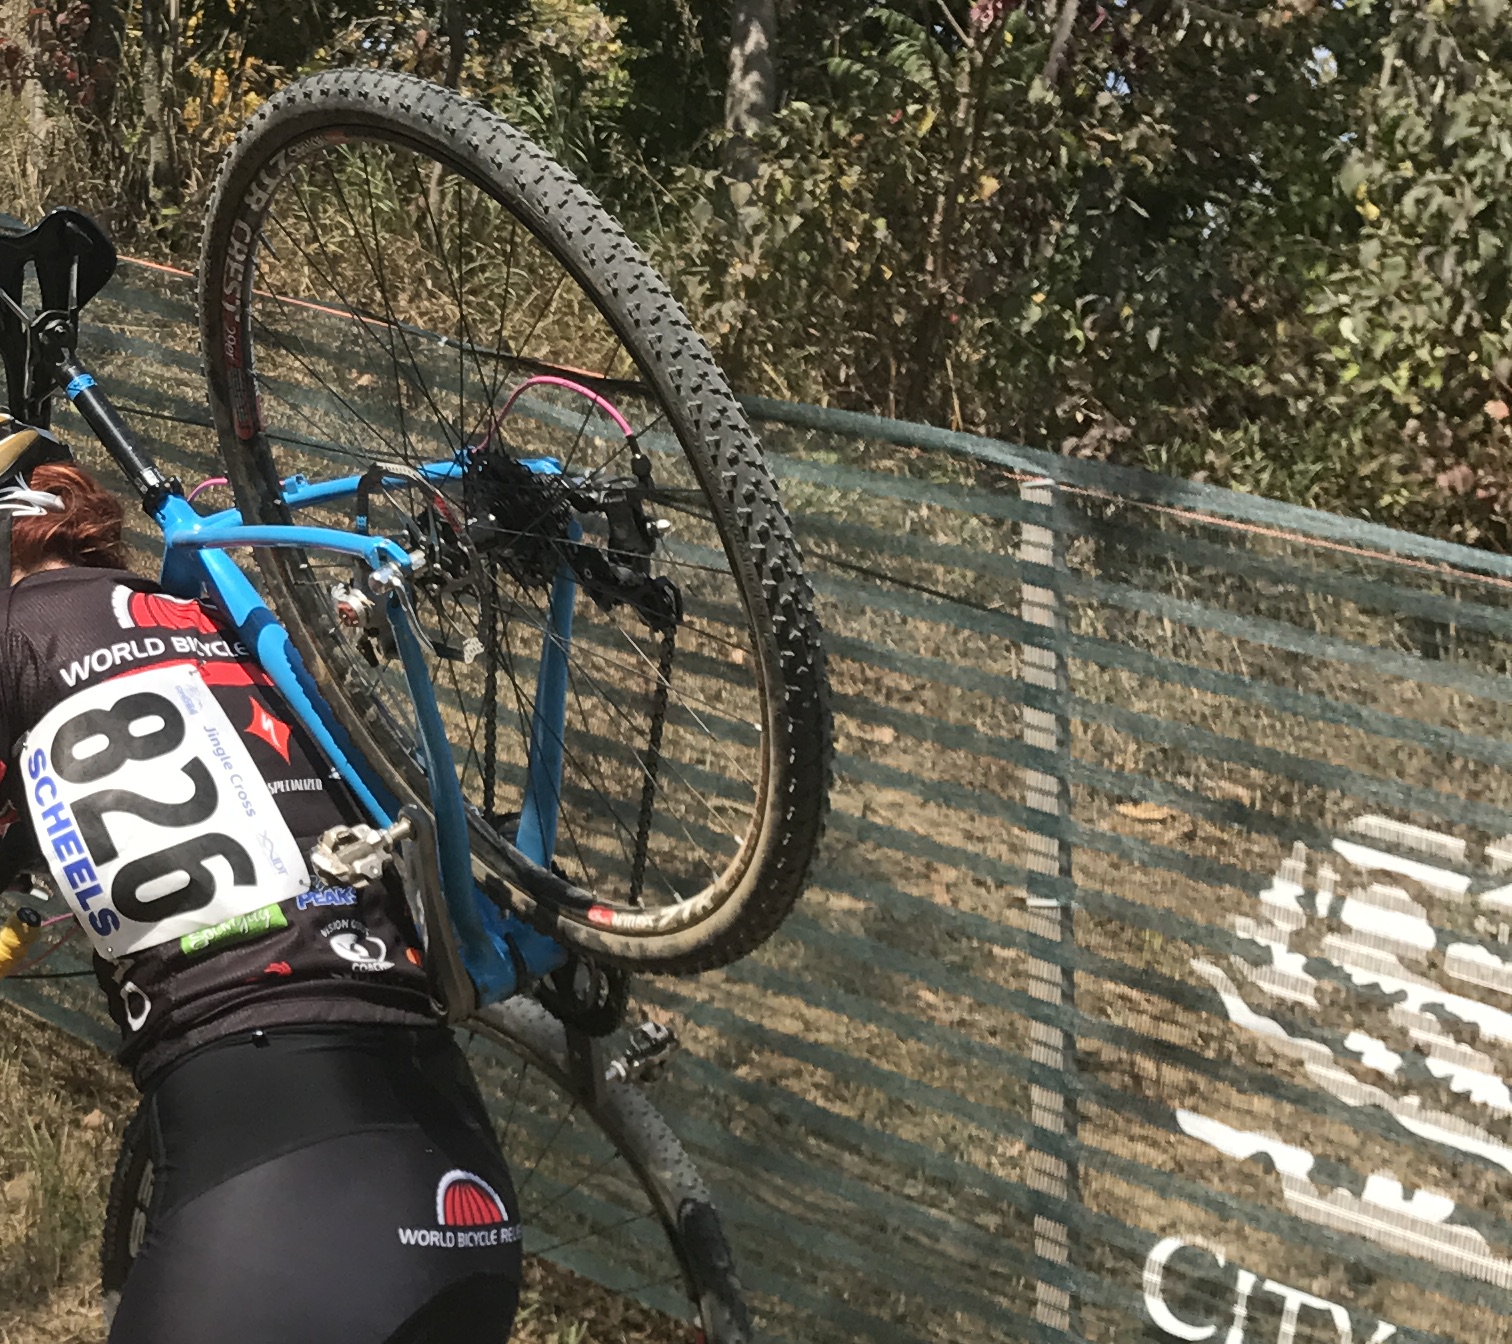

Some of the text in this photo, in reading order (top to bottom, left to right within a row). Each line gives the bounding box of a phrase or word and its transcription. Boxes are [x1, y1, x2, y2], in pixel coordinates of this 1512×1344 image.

[59, 636, 250, 688] WORLD BICYCLE
[52, 691, 258, 924] 826
[204, 725, 256, 817] Jingle Cross
[27, 747, 121, 937] SCHEELS
[398, 1226, 455, 1248] WORLD
[457, 1229, 498, 1248] BICYCLE
